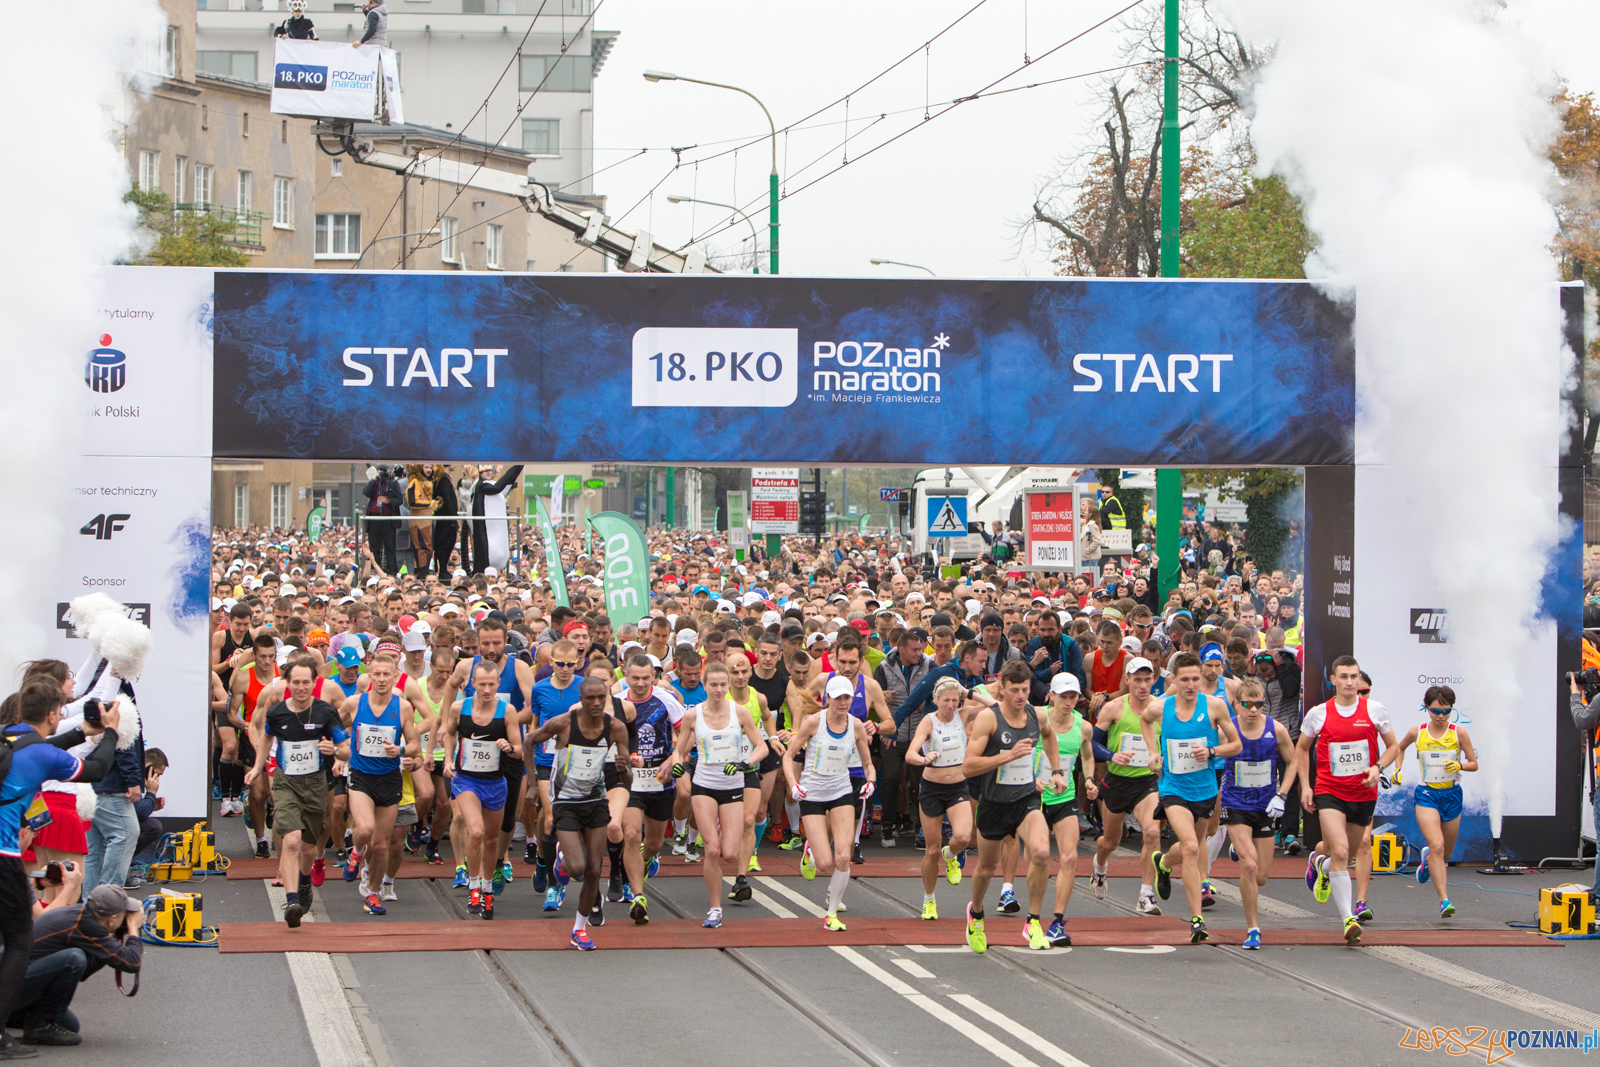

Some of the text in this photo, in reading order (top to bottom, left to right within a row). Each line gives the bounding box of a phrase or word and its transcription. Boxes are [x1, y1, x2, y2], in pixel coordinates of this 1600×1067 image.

[280, 71, 323, 84] 18. PKO
[331, 80, 373, 90] maraton
[105, 308, 154, 321] tytularny
[342, 347, 508, 388] START
[649, 351, 783, 382] 18. PKO
[1073, 353, 1234, 393] START
[813, 366, 940, 392] maraton
[832, 393, 872, 403] Macieja
[876, 393, 941, 403] Frankiewicza
[105, 405, 140, 418] Polski
[101, 485, 159, 499] techniczny
[79, 513, 131, 540] 4F
[1057, 547, 1069, 561] 3:10
[606, 532, 638, 611] 3:00
[82, 576, 126, 588] Sponsor
[290, 751, 313, 762] 6041
[472, 750, 491, 760] 786
[1178, 752, 1195, 760] PAC
[1338, 752, 1363, 763] 6218
[585, 758, 592, 768] 5
